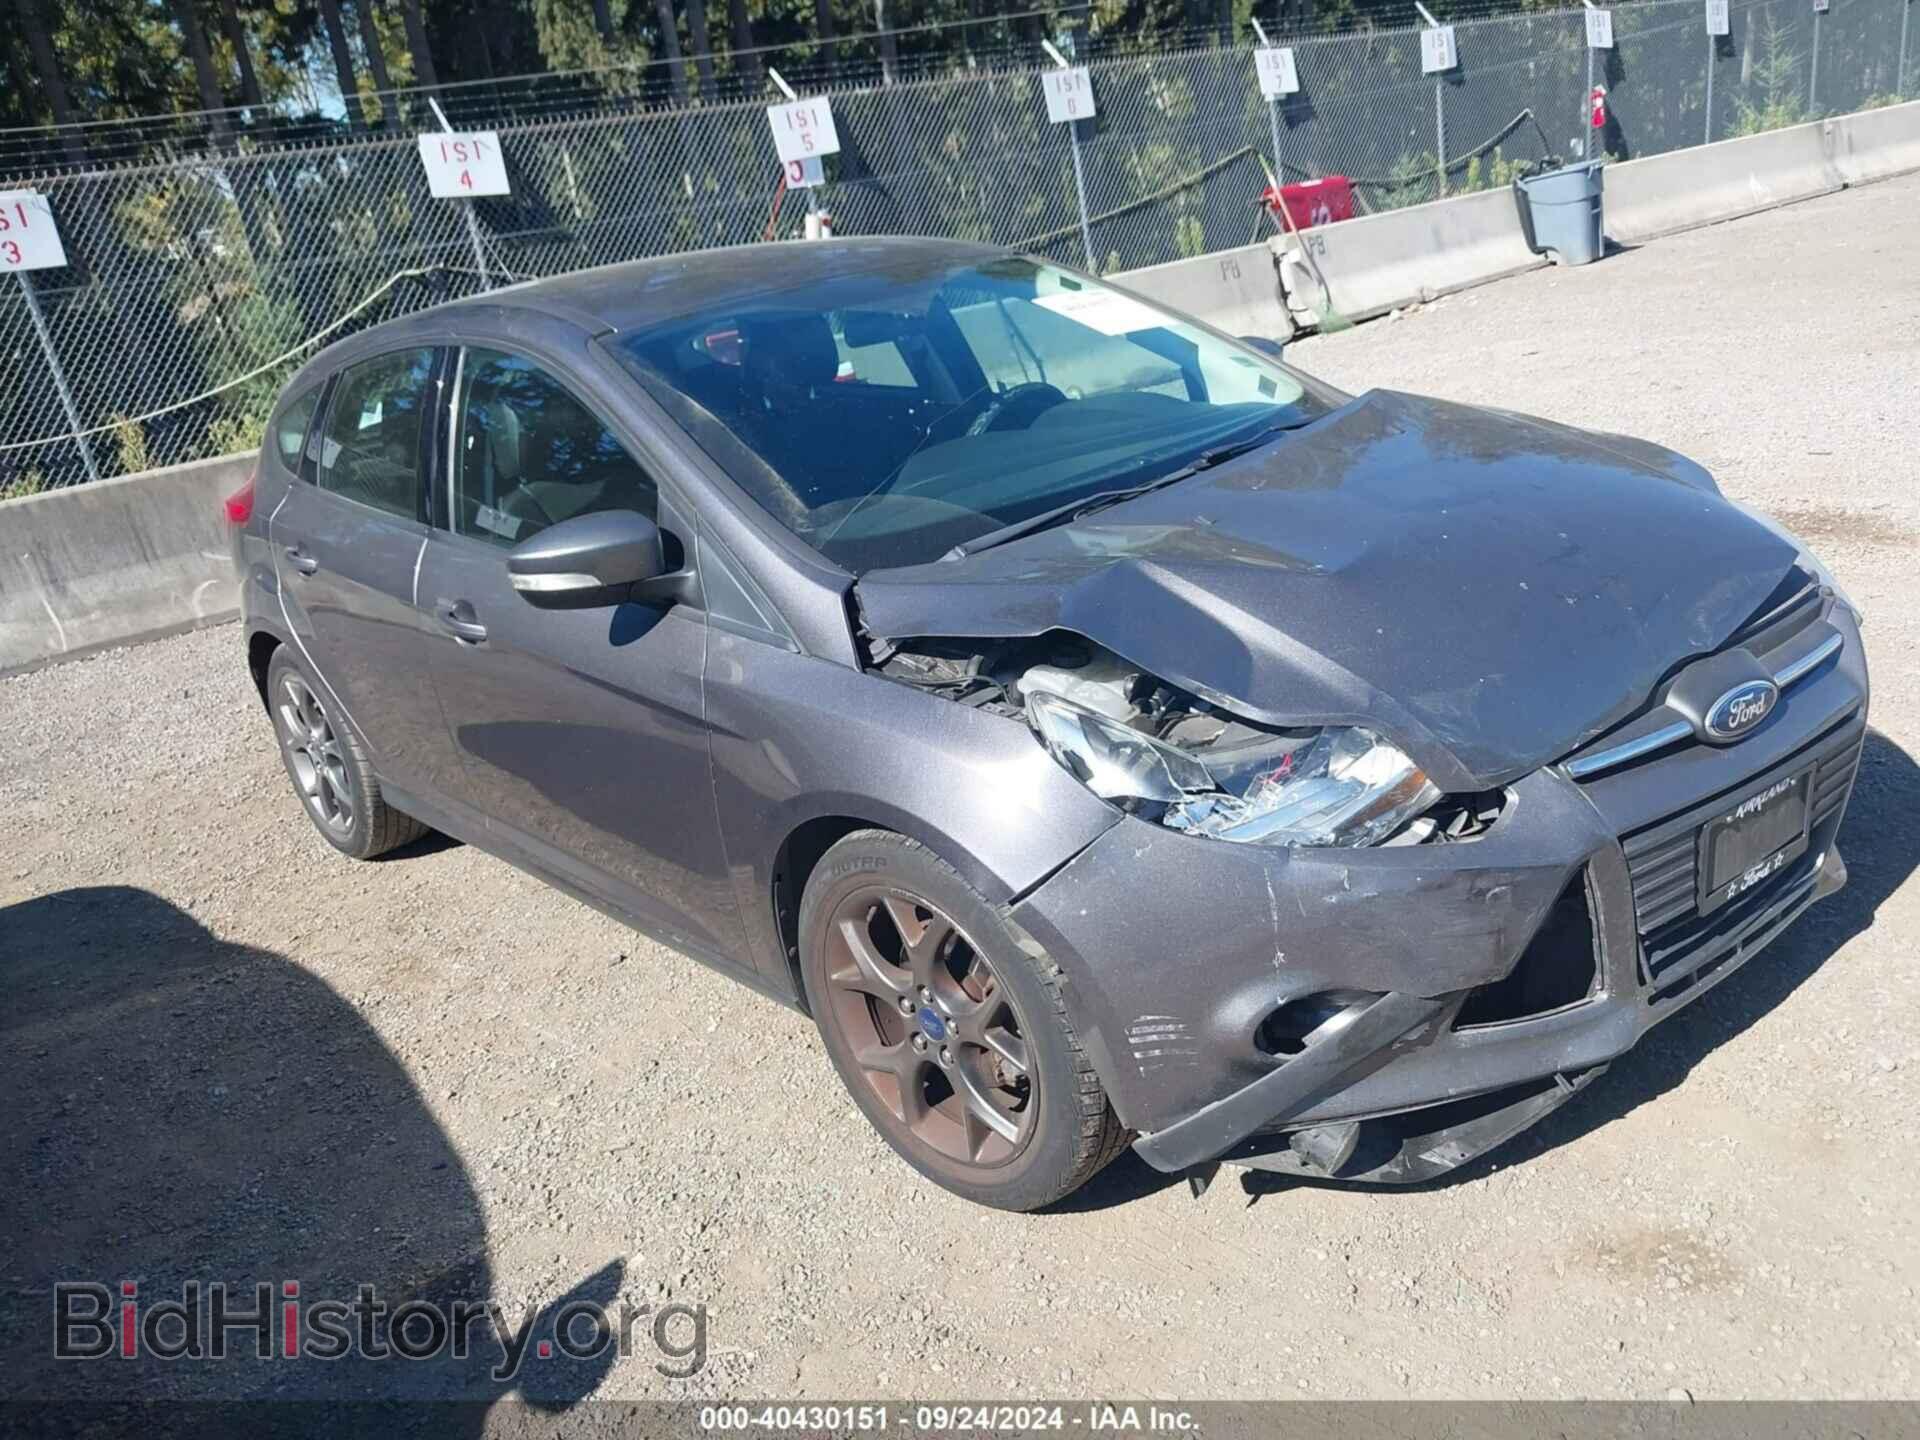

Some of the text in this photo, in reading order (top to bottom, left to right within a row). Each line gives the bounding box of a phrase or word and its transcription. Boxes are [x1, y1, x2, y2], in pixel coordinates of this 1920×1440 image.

[1274, 74, 1282, 89] 7
[802, 131, 814, 151] 5
[460, 168, 472, 190] 4
[1, 241, 21, 263] 3
[1728, 691, 1767, 729] Ford
